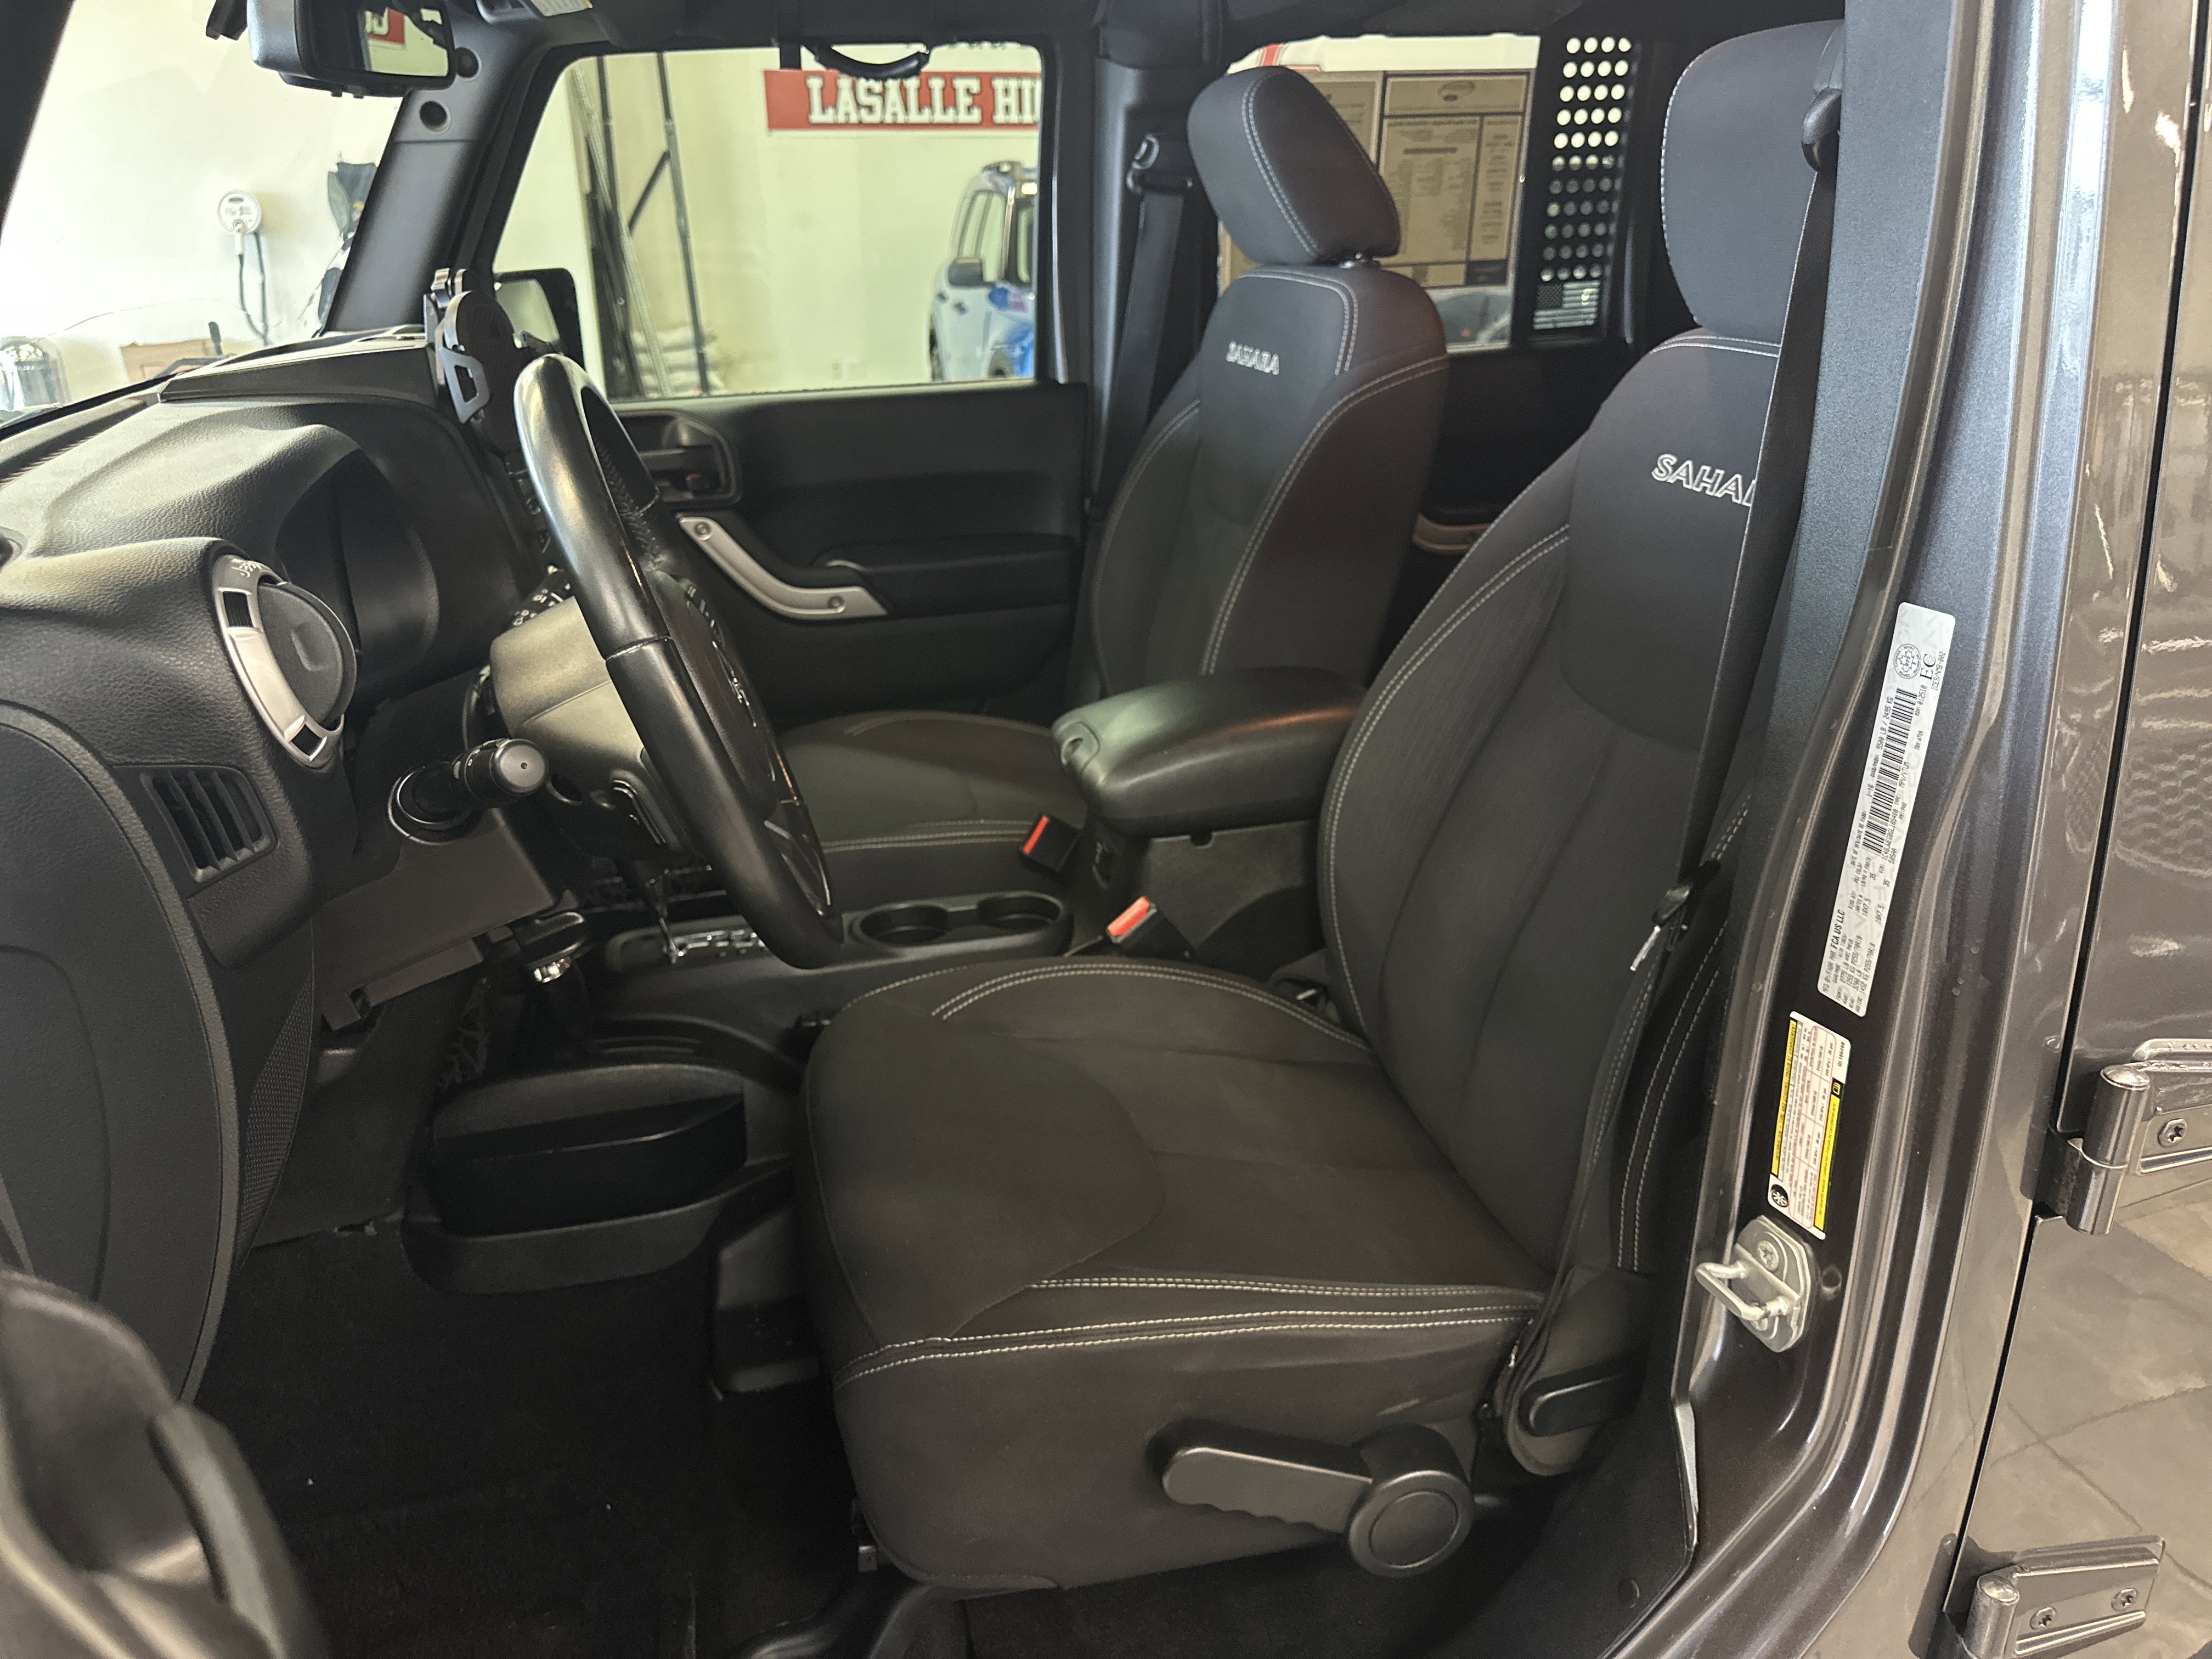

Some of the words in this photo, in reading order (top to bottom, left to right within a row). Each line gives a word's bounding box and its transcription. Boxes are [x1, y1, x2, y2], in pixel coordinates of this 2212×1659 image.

[806, 76, 981, 124] LASALLE
[992, 76, 1041, 124] HI
[1226, 341, 1279, 375] SAHARA
[1651, 453, 1756, 507] SAHA
[1886, 695, 1893, 704] KG
[1916, 684, 1927, 705] 012510
[1883, 704, 1891, 719] 2495
[1880, 726, 1887, 735] LB
[1876, 736, 1884, 750] 5500
[1866, 783, 1874, 797] 1-16
[1882, 878, 1890, 887] 35
[1836, 909, 1845, 923] LLC
[1849, 964, 1855, 973] KG
[1869, 872, 1876, 881] 35
[1833, 923, 1842, 934] US
[1830, 934, 1839, 949] FCA
[1842, 961, 1849, 970] LB
[1855, 968, 1862, 977] LB
[1839, 969, 1848, 984] 2775
[1861, 972, 1869, 981] KG
[1859, 980, 1867, 995] 1452
